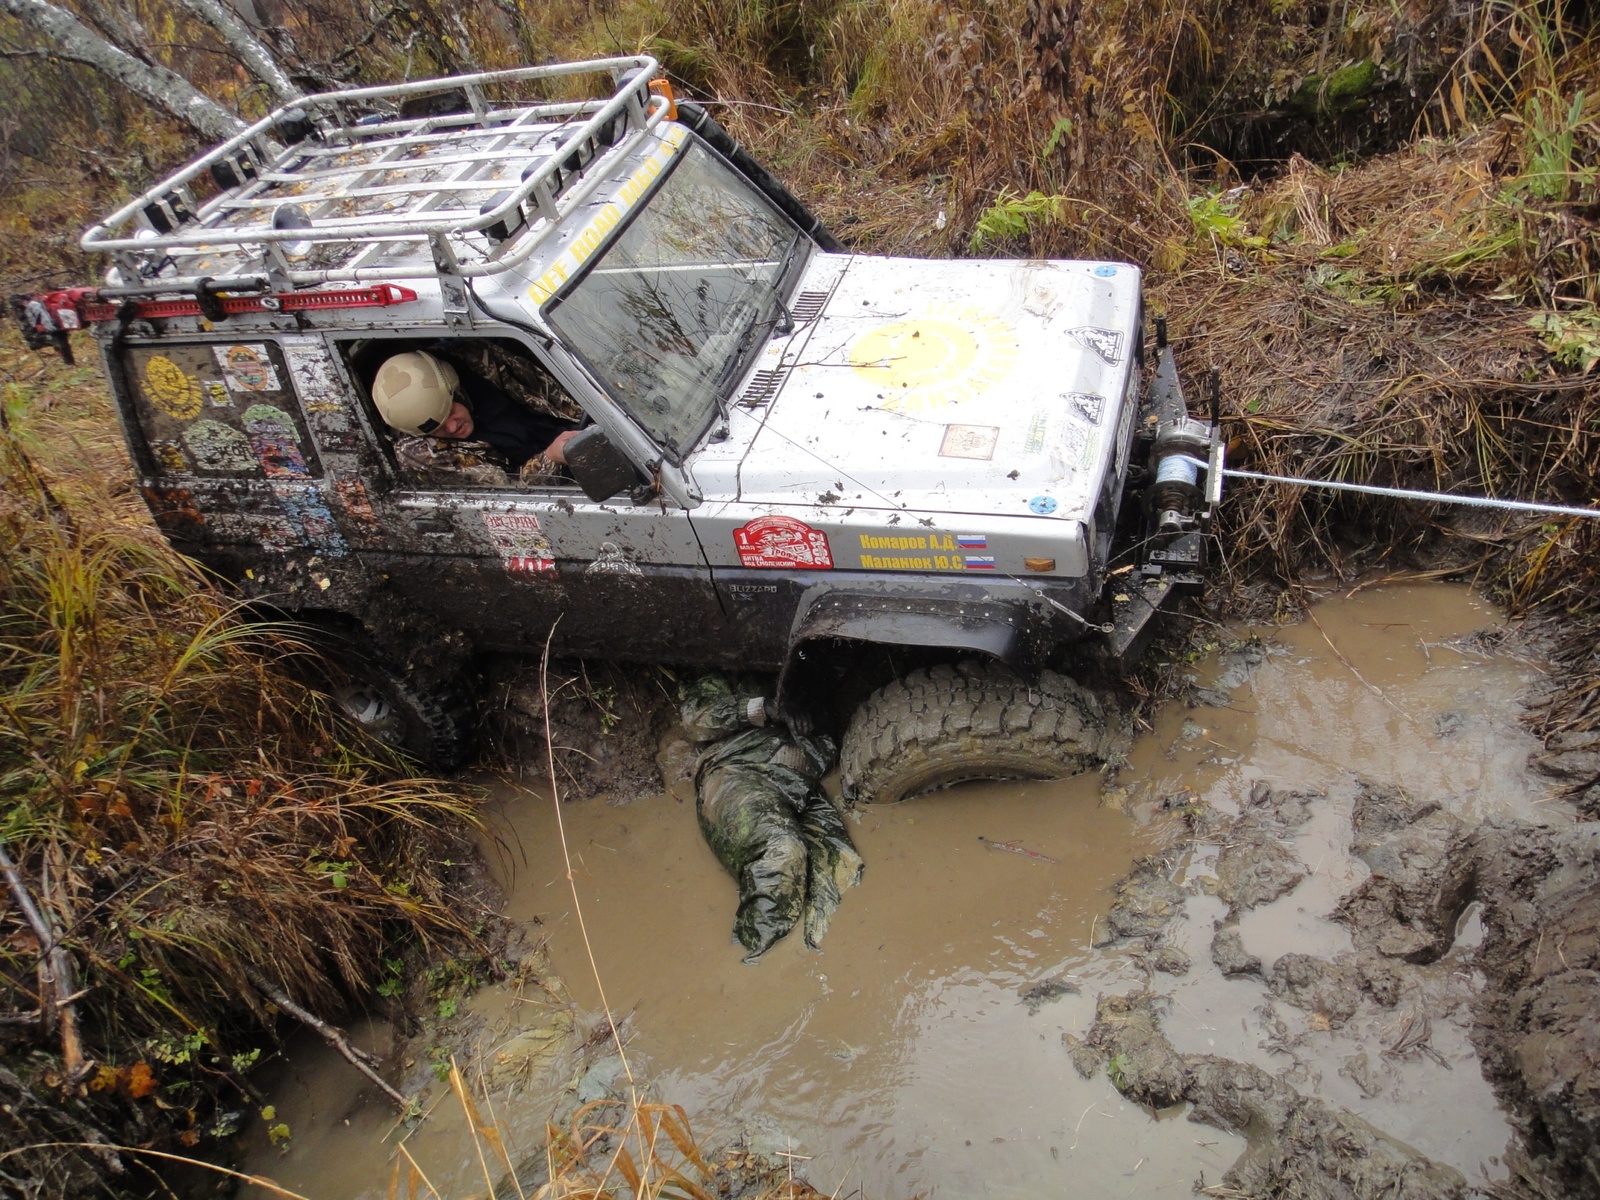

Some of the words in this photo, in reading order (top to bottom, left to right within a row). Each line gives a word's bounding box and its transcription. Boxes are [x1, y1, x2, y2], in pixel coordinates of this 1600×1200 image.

[528, 258, 568, 305] OFF
[569, 204, 621, 264] ROAD
[739, 532, 748, 545] 1
[859, 534, 927, 551] Комаров
[860, 554, 932, 569] Маланюк
[933, 555, 966, 570] Ю.С.
